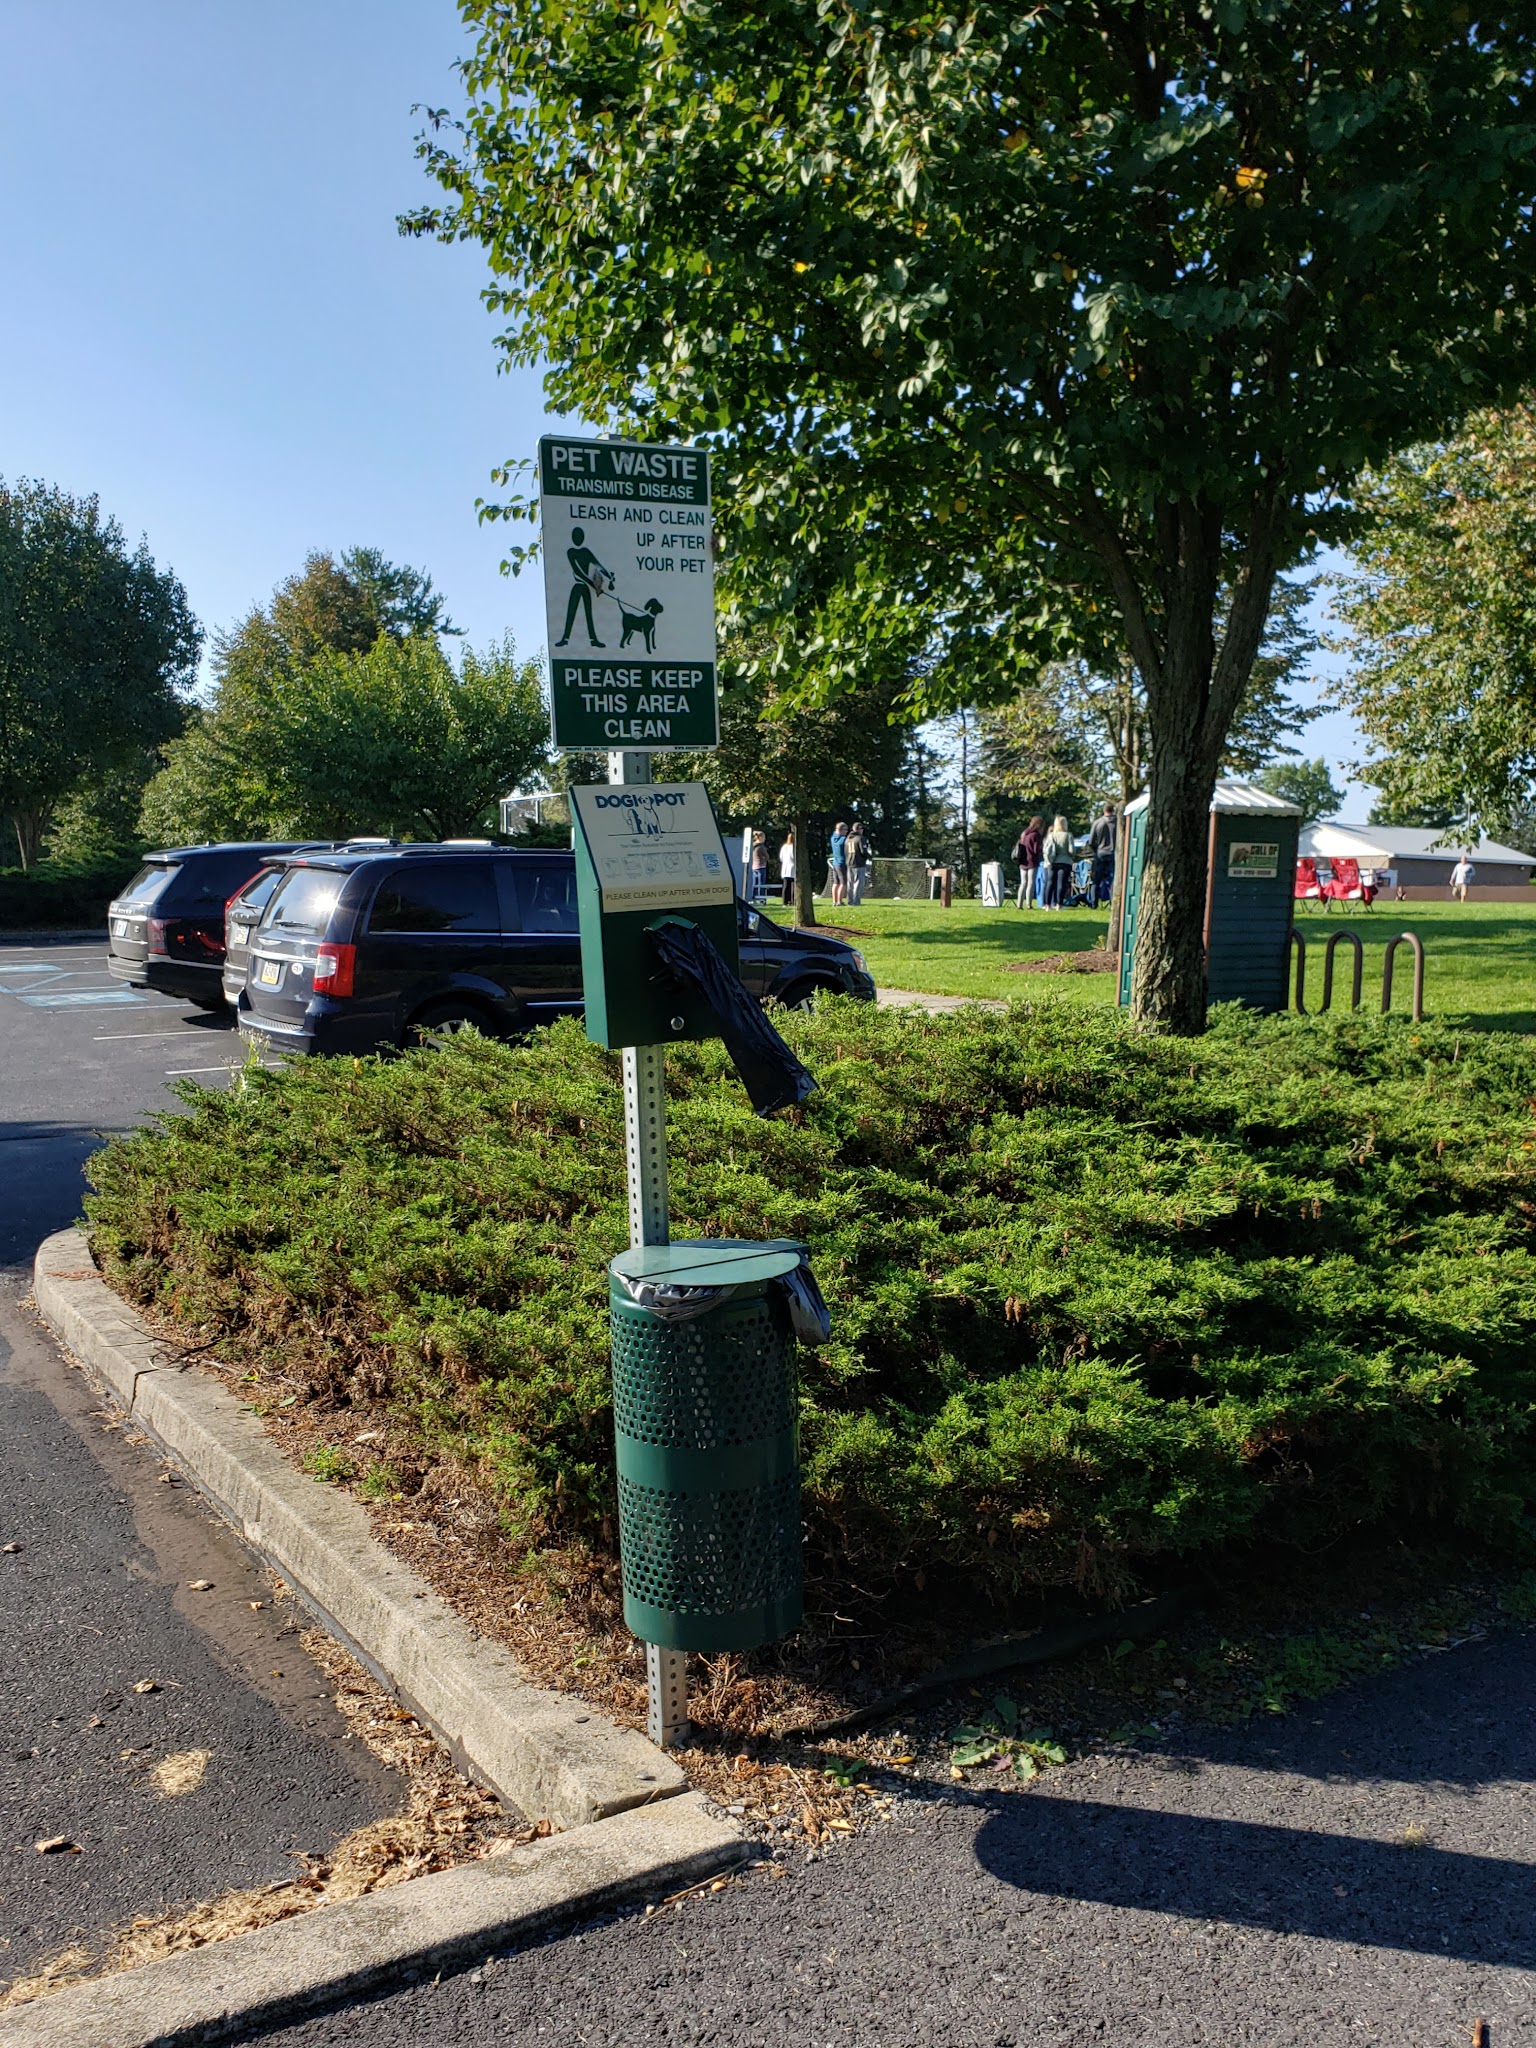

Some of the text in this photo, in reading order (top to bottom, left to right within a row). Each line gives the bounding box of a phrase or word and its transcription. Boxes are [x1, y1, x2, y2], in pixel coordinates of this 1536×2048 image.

[551, 446, 697, 481] PET WASTE
[557, 477, 695, 500] TRANSMITS DISEASE
[569, 504, 705, 526] LEASH AND CLEAN
[636, 532, 705, 550] UP AFTER
[636, 556, 706, 574] YOUR PET
[564, 668, 703, 689] PLEASE KEEP
[581, 693, 690, 713] THIS AREA
[604, 719, 672, 739] CLEAN
[606, 892, 632, 901] PLEASE
[633, 891, 657, 899] CLEAN
[669, 888, 690, 897] AFTER
[691, 887, 711, 895] YOUR
[711, 886, 730, 894] DOG!
